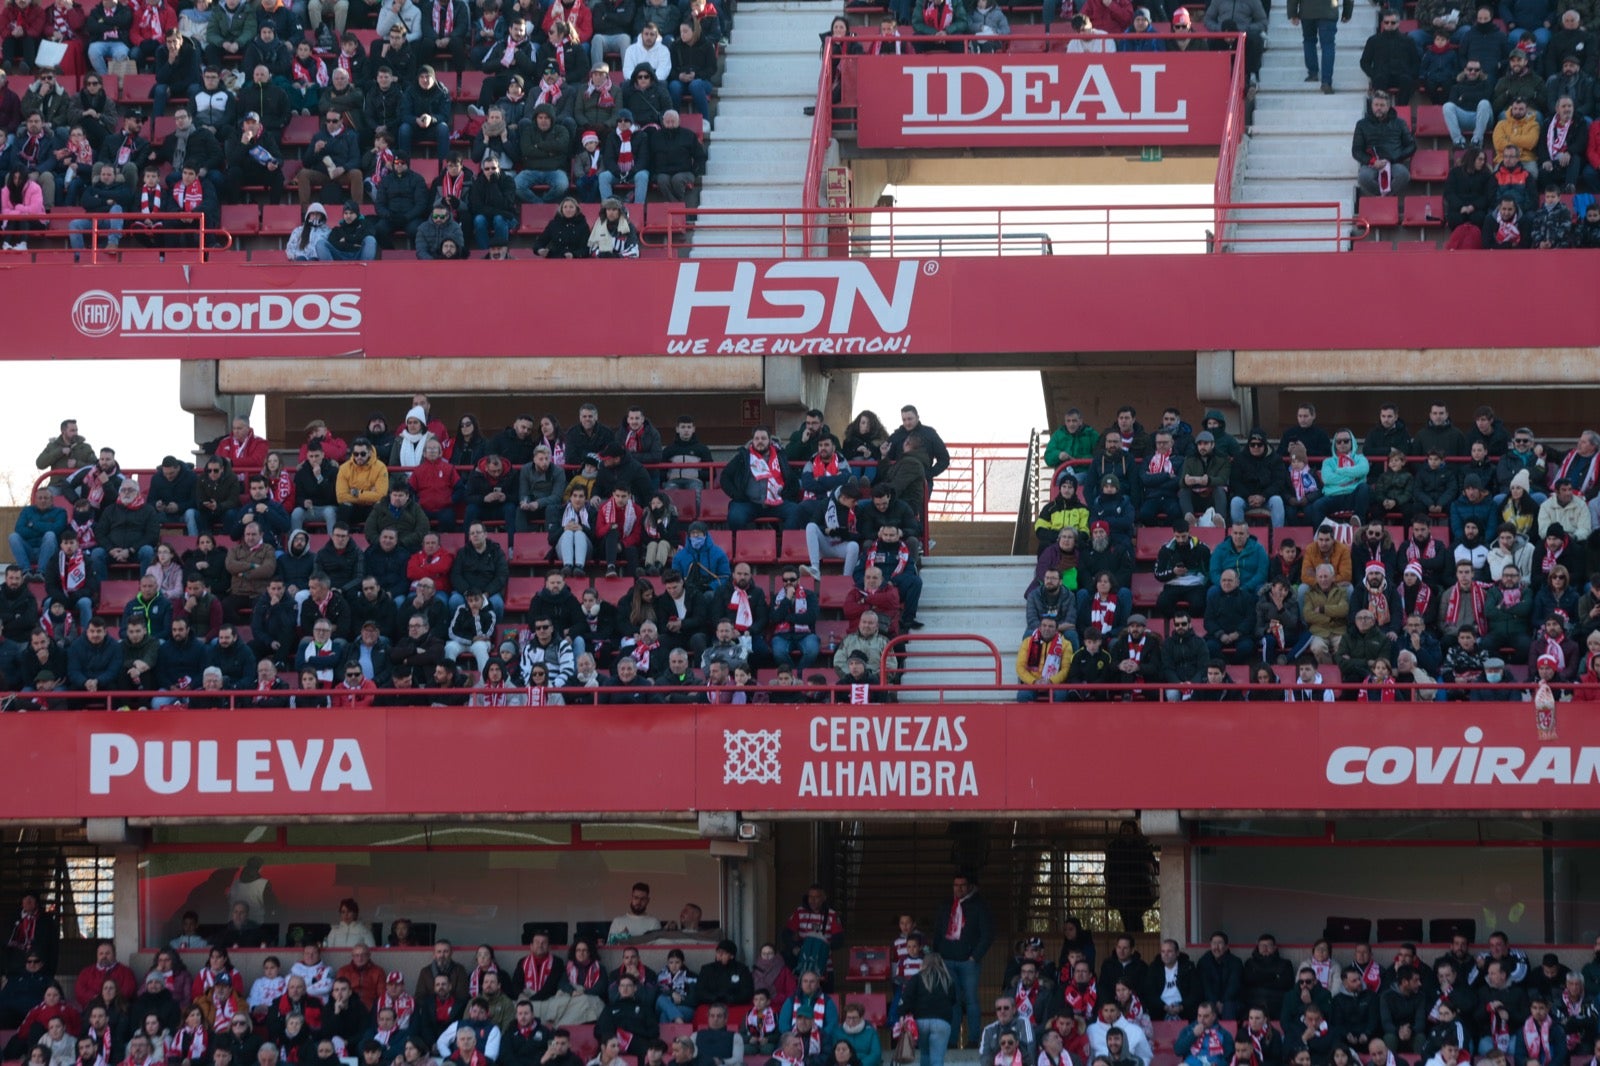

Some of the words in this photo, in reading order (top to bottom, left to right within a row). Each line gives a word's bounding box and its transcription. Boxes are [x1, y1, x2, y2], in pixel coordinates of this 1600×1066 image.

[903, 64, 1187, 121] IDEAL
[84, 304, 110, 324] FIAT
[121, 293, 362, 331] MotorDOS
[666, 260, 919, 334] HSN
[666, 338, 709, 355] WE
[717, 337, 767, 354] ARE
[769, 334, 912, 354] NUTRITION!
[809, 716, 969, 752] CERVEZAS
[90, 733, 373, 794] PULEVA
[798, 761, 979, 796] ALHAMBRA
